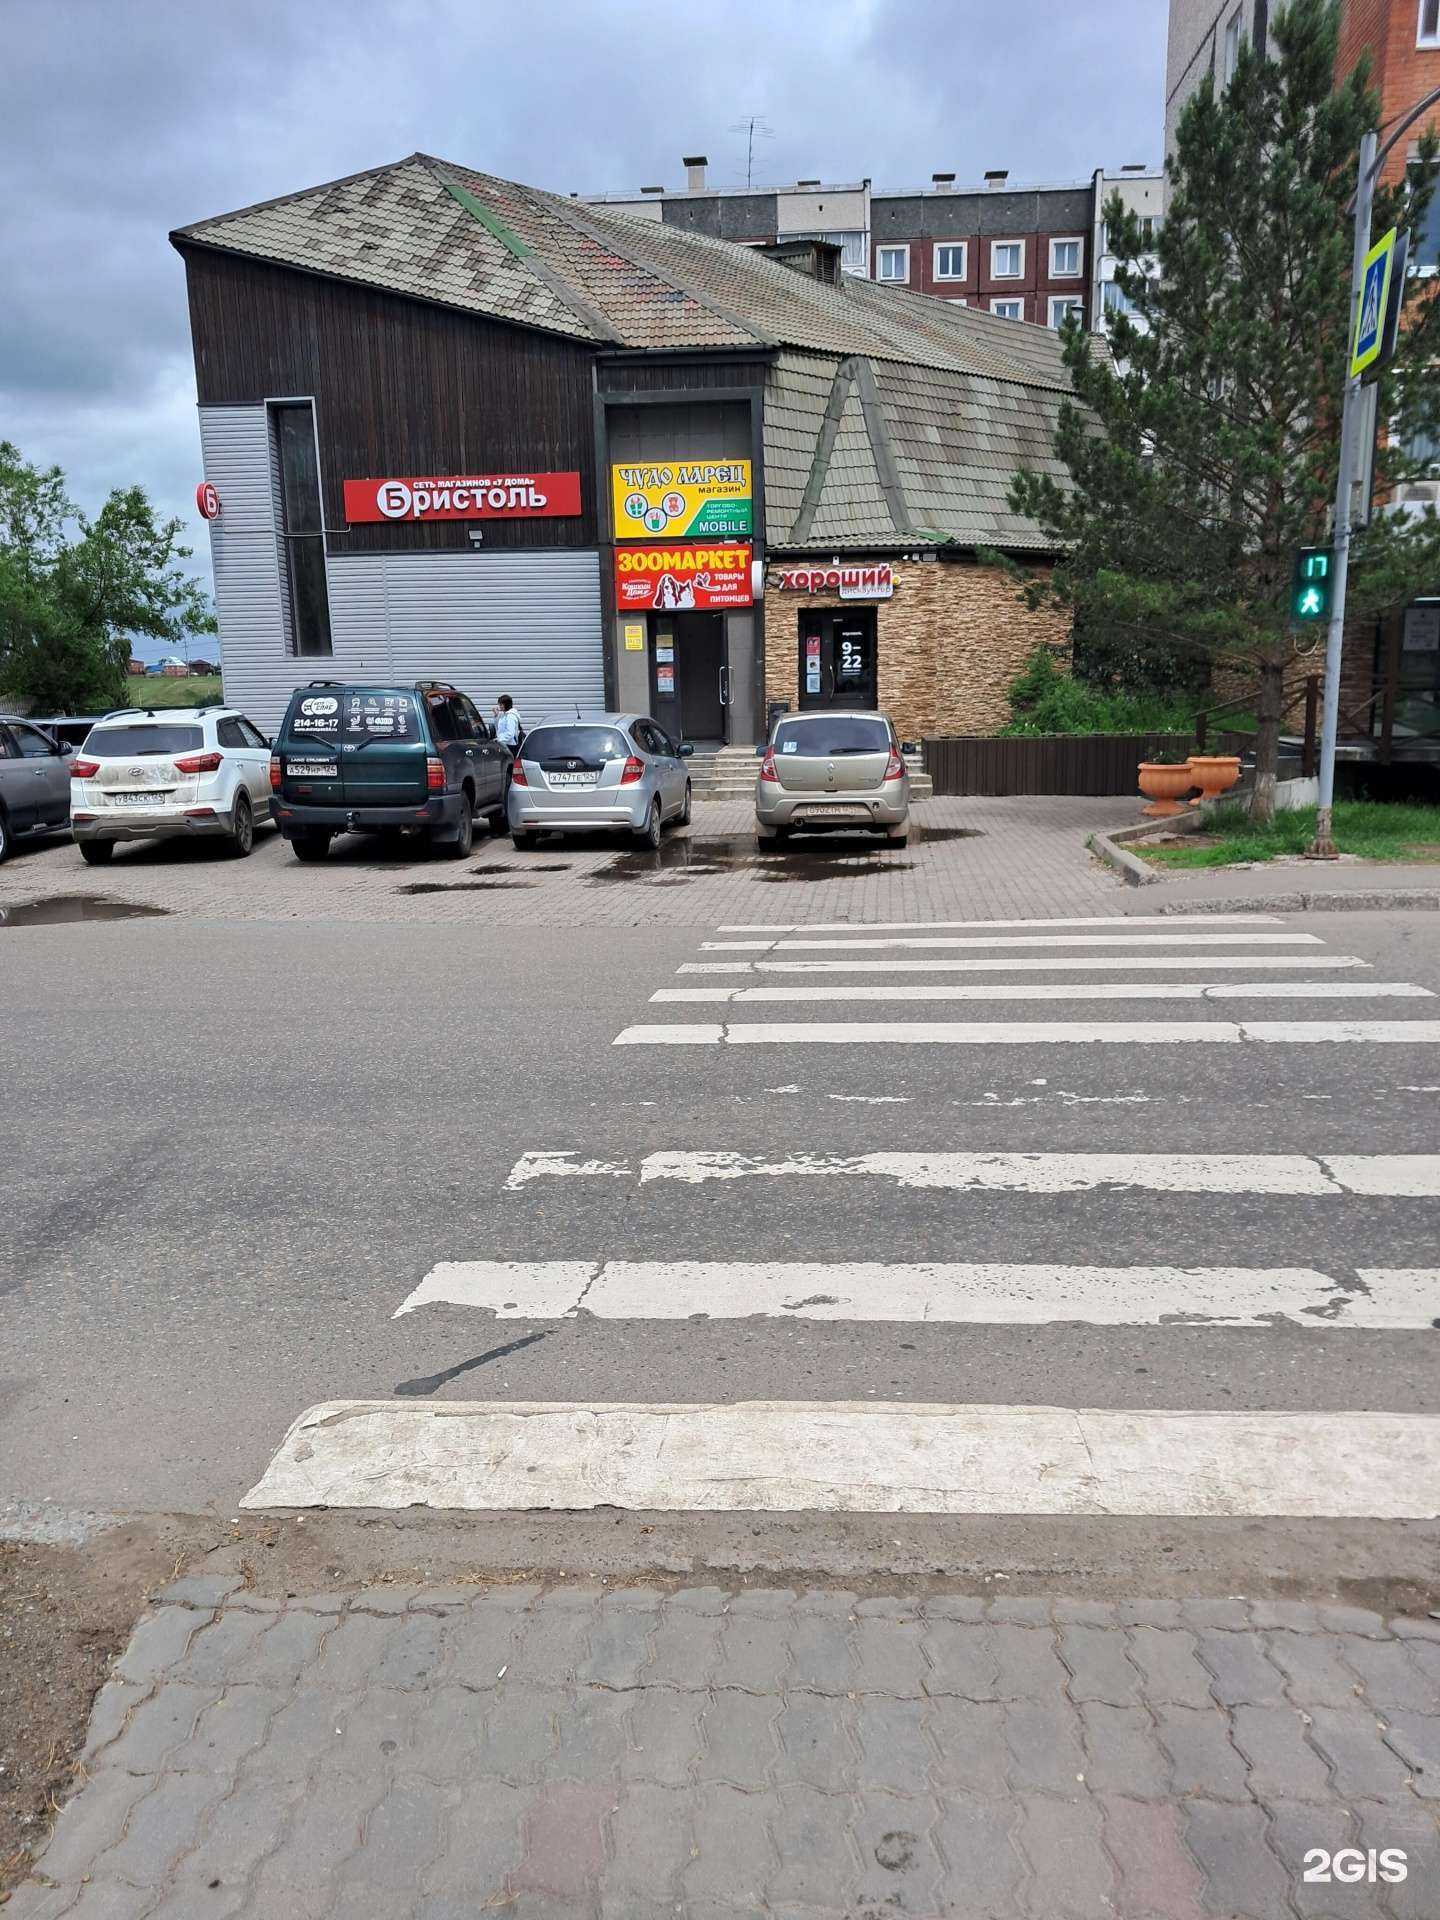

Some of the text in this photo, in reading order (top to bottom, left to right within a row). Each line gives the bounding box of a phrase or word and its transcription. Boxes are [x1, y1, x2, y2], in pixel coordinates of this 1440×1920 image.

[619, 465, 746, 489] ЧУДО ЛАРЕЦ
[413, 480, 436, 489] СЕТЬ
[437, 480, 490, 488] МАГАЗИНОВ
[699, 486, 741, 494] магазин
[385, 485, 548, 516] Бристоль
[699, 520, 747, 532] MOBILE
[618, 550, 750, 572] ЗООМАРКЕТ
[1307, 556, 1328, 577] 17
[714, 573, 744, 581] ТОВАРЫ
[721, 583, 738, 591] ДЛЯ
[710, 594, 750, 603] ПИТОМЦЕВ
[842, 655, 862, 668] 22
[294, 719, 339, 728] 214-16-17
